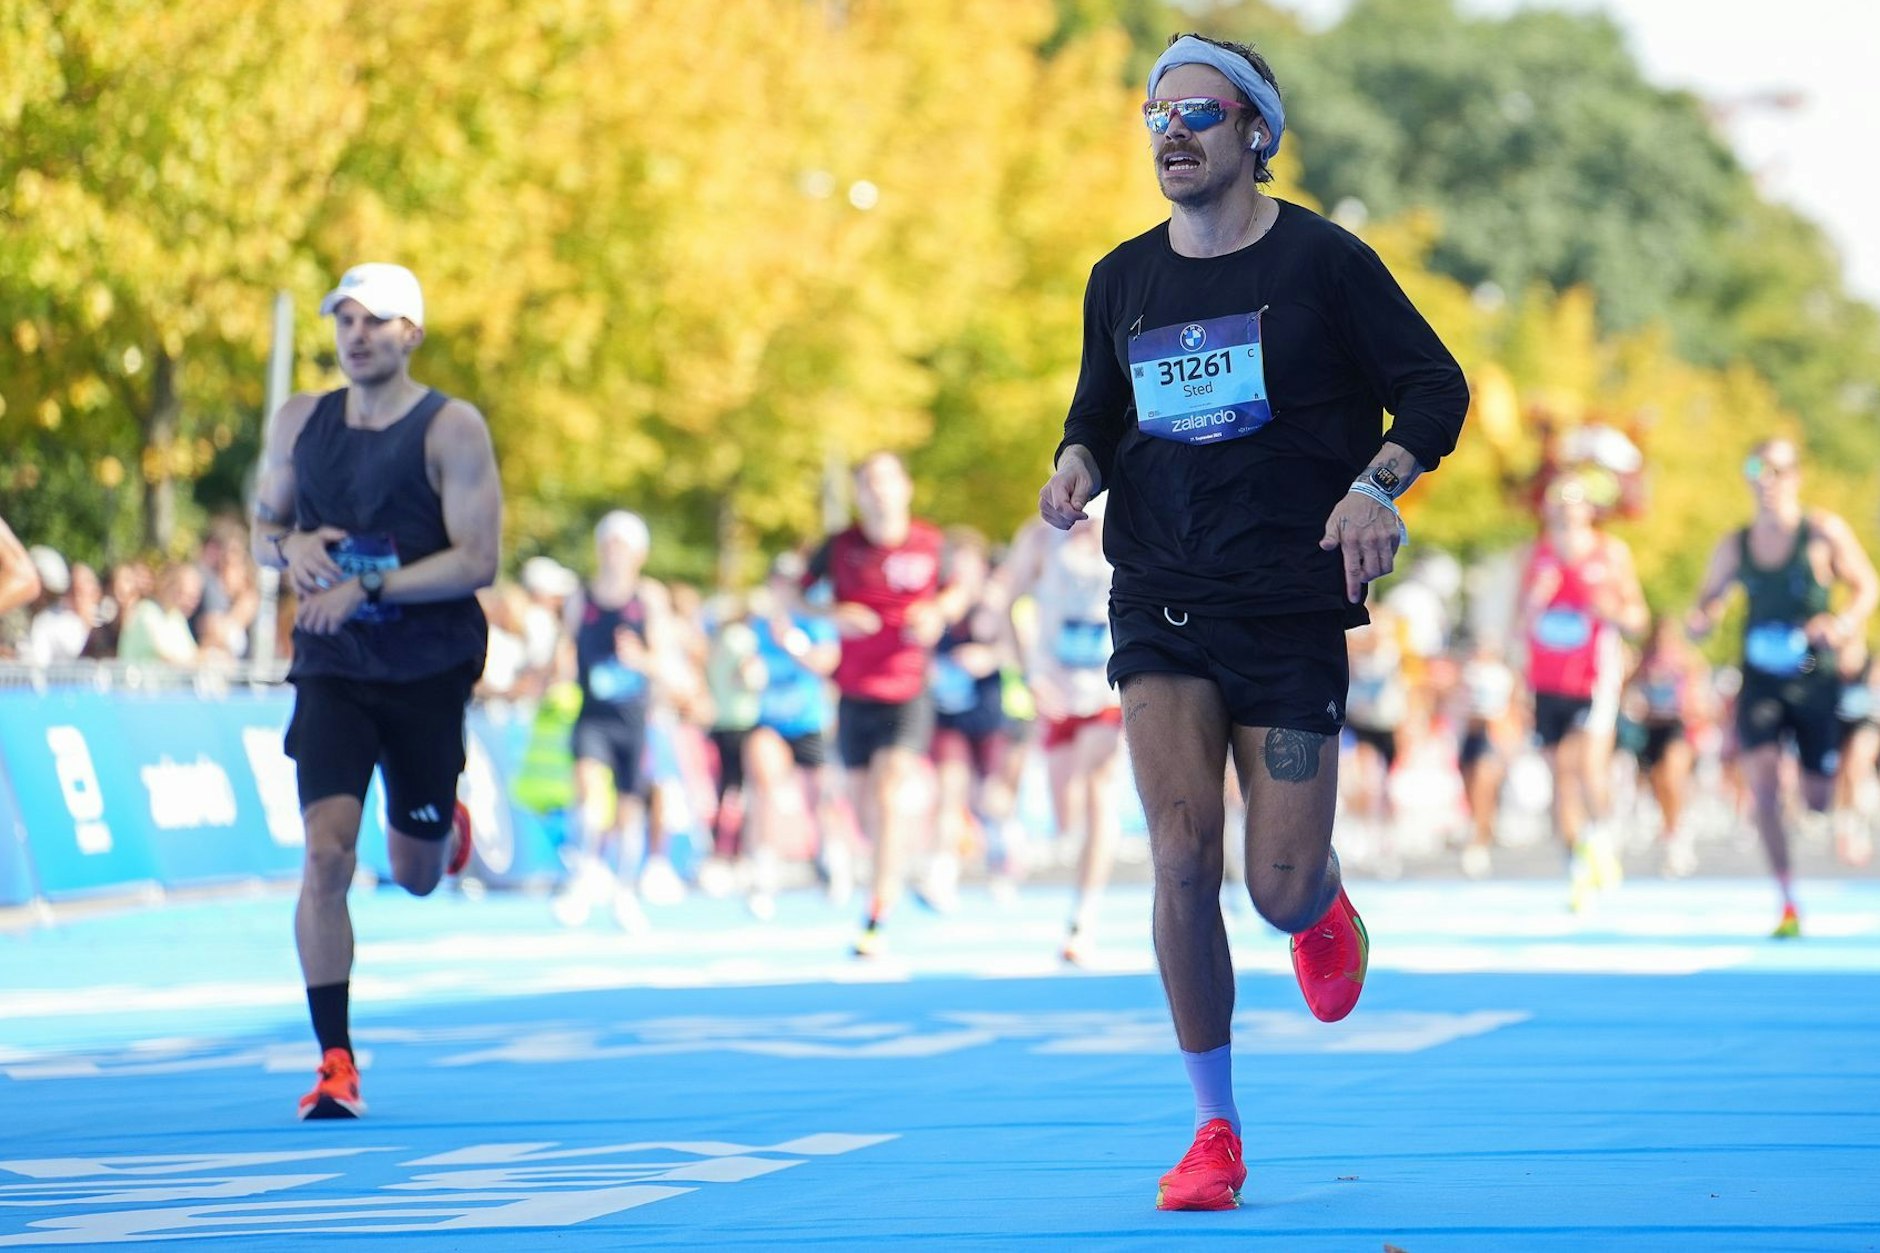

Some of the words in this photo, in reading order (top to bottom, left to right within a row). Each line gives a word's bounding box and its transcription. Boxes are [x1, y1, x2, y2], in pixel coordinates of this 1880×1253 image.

[1247, 348, 1255, 358] C
[1157, 350, 1232, 386] 31261
[1183, 381, 1213, 398] Sted
[1171, 409, 1236, 433] zalando
